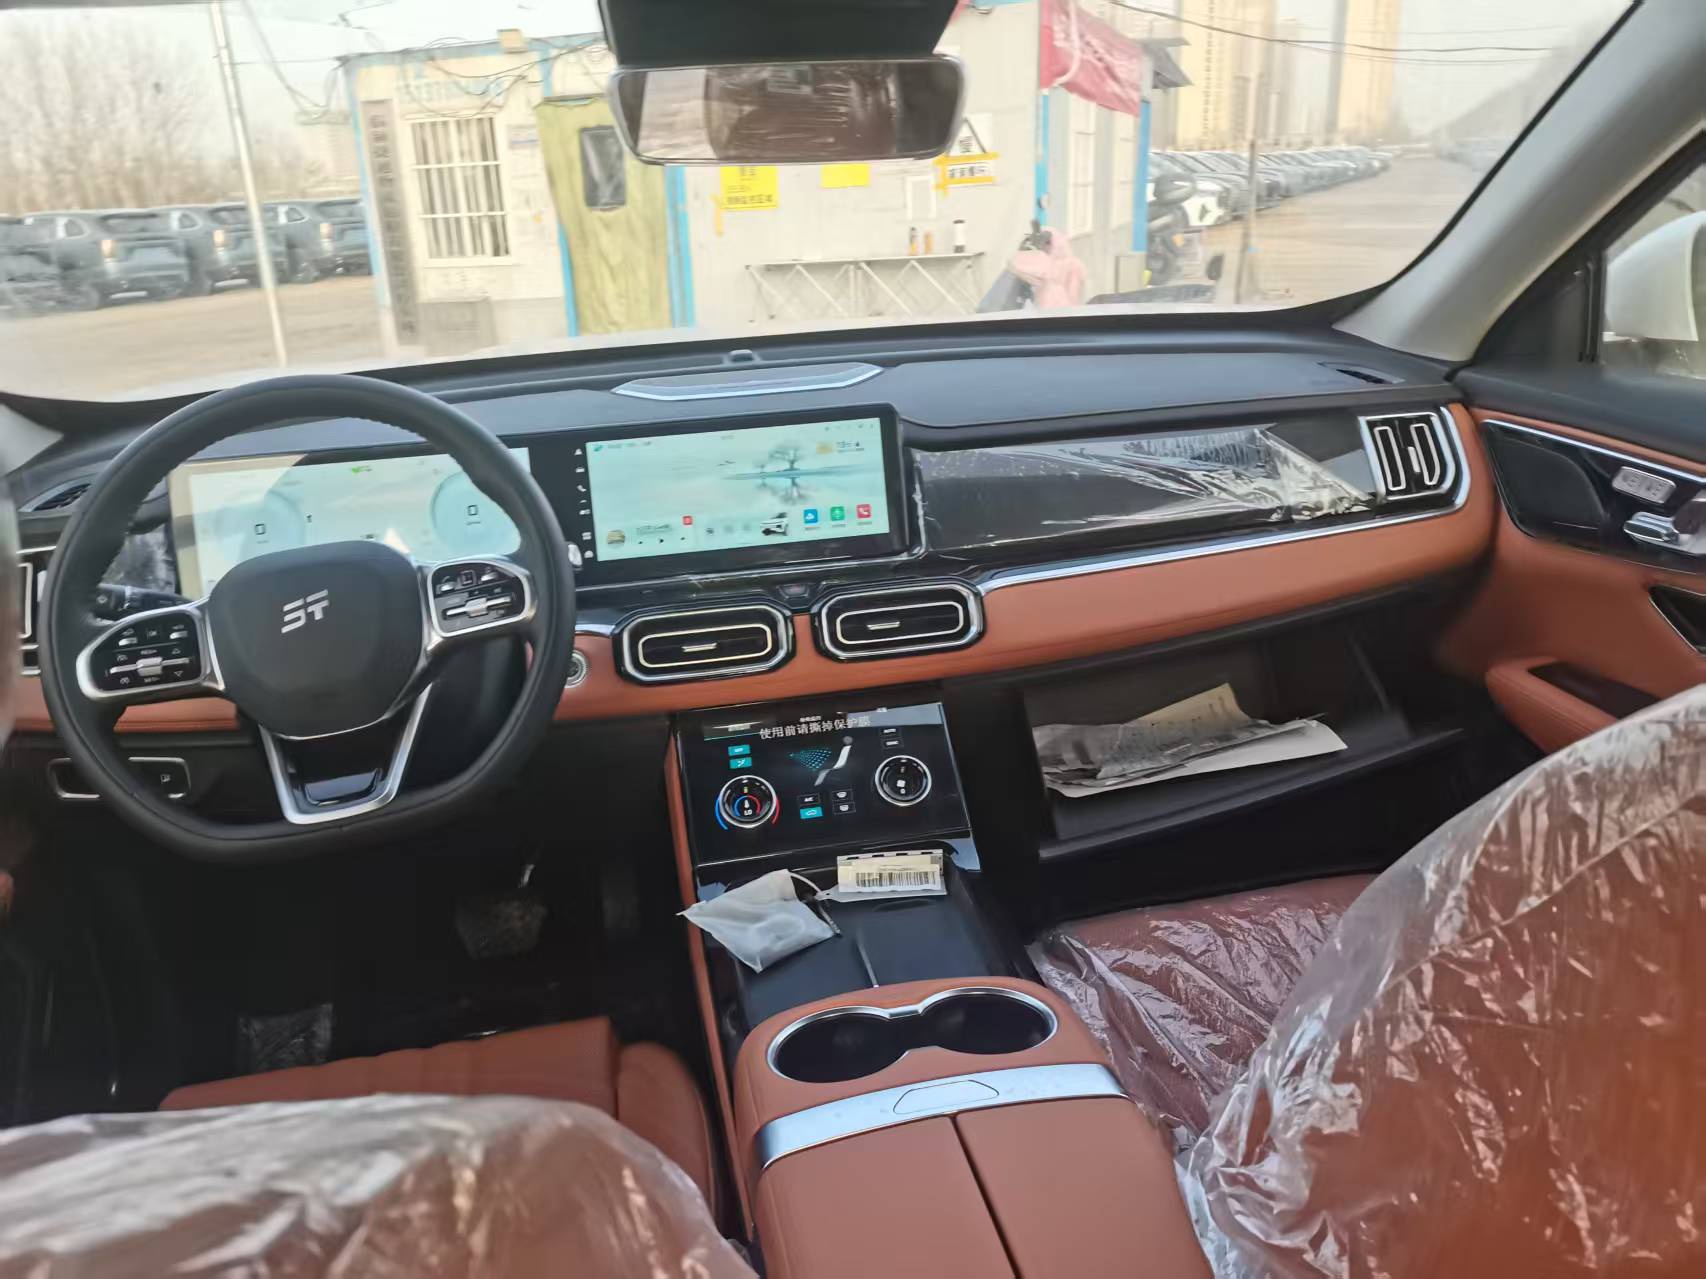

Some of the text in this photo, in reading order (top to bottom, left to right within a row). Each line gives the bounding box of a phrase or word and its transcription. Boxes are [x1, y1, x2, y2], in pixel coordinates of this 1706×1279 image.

[760, 715, 871, 739] 使用前请撕掉保护膜
